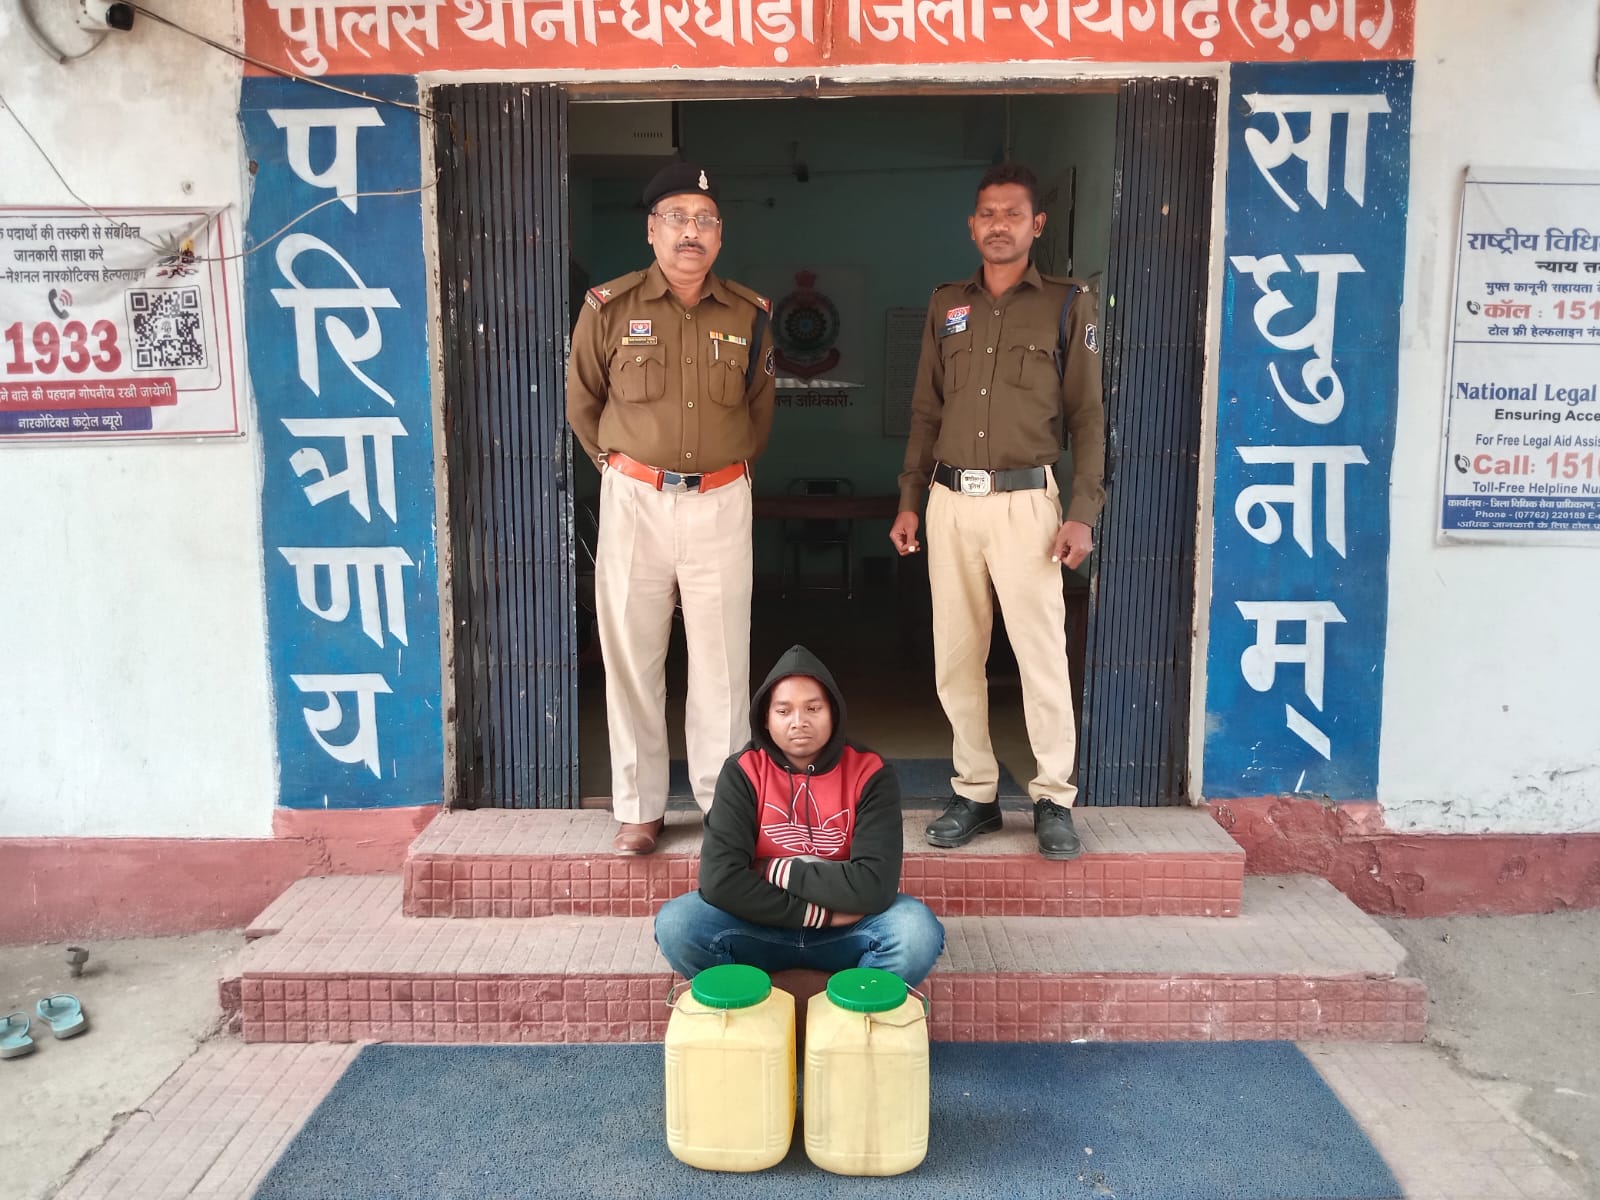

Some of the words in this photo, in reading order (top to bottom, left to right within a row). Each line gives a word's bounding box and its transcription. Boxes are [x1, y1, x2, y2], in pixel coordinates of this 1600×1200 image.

[41, 224, 54, 241] की
[57, 224, 90, 240] तस्करी
[92, 224, 101, 240] से
[1467, 227, 1540, 254] राष्ट्रीय
[14, 245, 58, 262] जानकारी
[61, 248, 86, 262] साझा
[43, 266, 99, 283] नारकोटिक्स
[102, 265, 146, 282] हेल्पलाइन
[1535, 261, 1578, 273] न्याय
[1485, 282, 1510, 295] मुफ्त
[1514, 280, 1547, 296] कानूनी
[1484, 299, 1532, 319] कॉल
[1488, 324, 1509, 336] टोल
[1512, 324, 1527, 336] फ्री
[5, 320, 122, 374] 1933
[12, 386, 28, 402] वाले
[32, 385, 44, 400] की
[47, 388, 75, 401] पहचान
[79, 384, 115, 399] गोपनीय
[119, 383, 136, 399] रखी
[141, 382, 172, 399] जायेगी
[1456, 382, 1538, 401] National
[1544, 384, 1597, 406] Legal
[18, 413, 69, 430] नारकोटिक्स
[102, 411, 123, 431] ब्यूरो
[1495, 409, 1561, 423] Ensuring
[1475, 434, 1493, 446] For
[1497, 434, 1520, 446] Free
[1523, 435, 1551, 449] Legal
[1554, 435, 1571, 447] Aid
[1473, 454, 1535, 475] Call:
[1546, 452, 1600, 479] 151
[1473, 482, 1525, 493] Toll-Free
[1529, 482, 1577, 496] Helpline
[1582, 483, 1600, 494] Nu
[1475, 510, 1506, 518] Phone
[1514, 511, 1549, 520] (07762)
